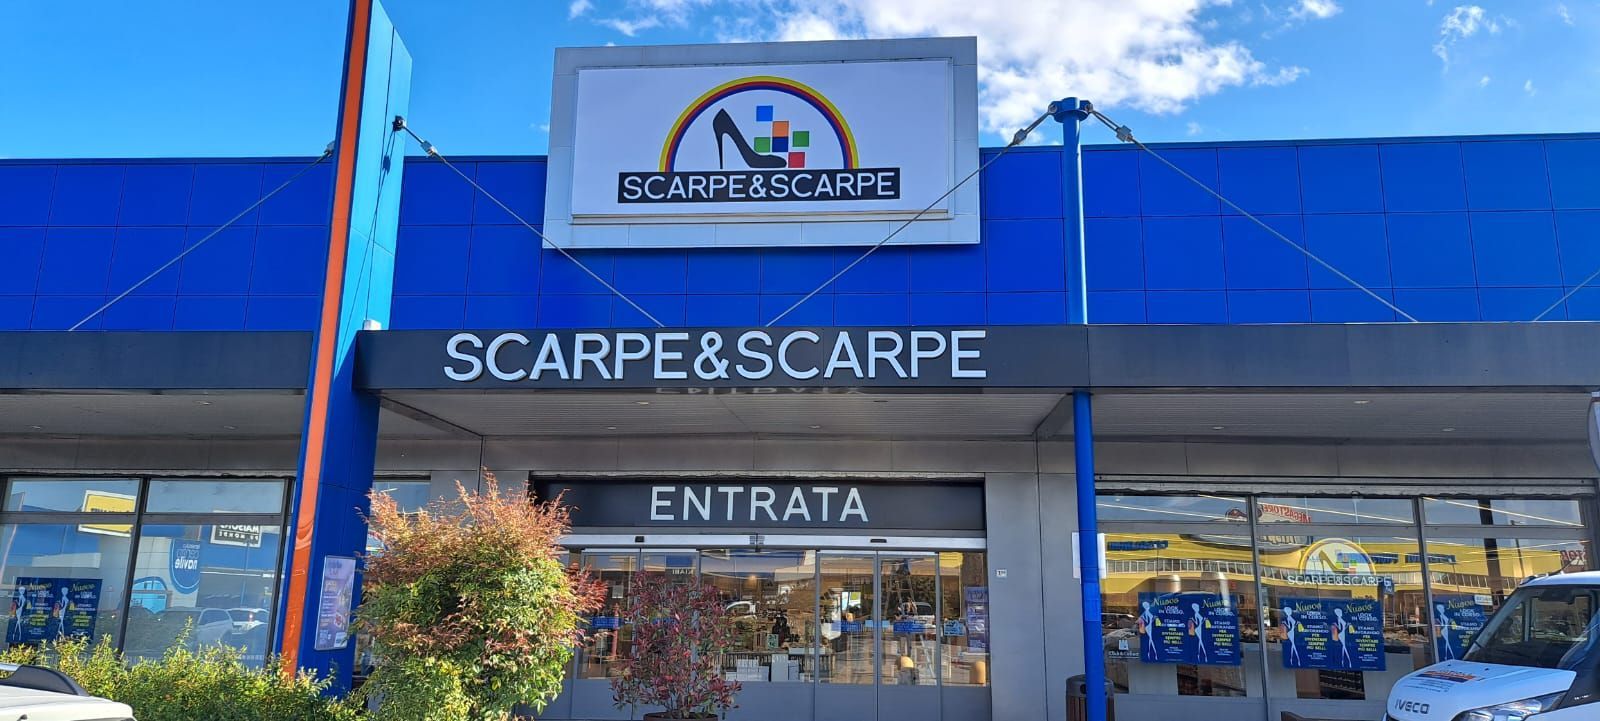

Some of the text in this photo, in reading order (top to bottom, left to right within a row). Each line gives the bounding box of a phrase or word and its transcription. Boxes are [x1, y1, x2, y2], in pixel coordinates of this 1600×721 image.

[623, 172, 895, 199] SCARPE&SCARPE
[443, 330, 987, 382] SCARPE&SCARPE
[651, 486, 869, 521] ENTRATA
[1395, 700, 1430, 714] IVECO
